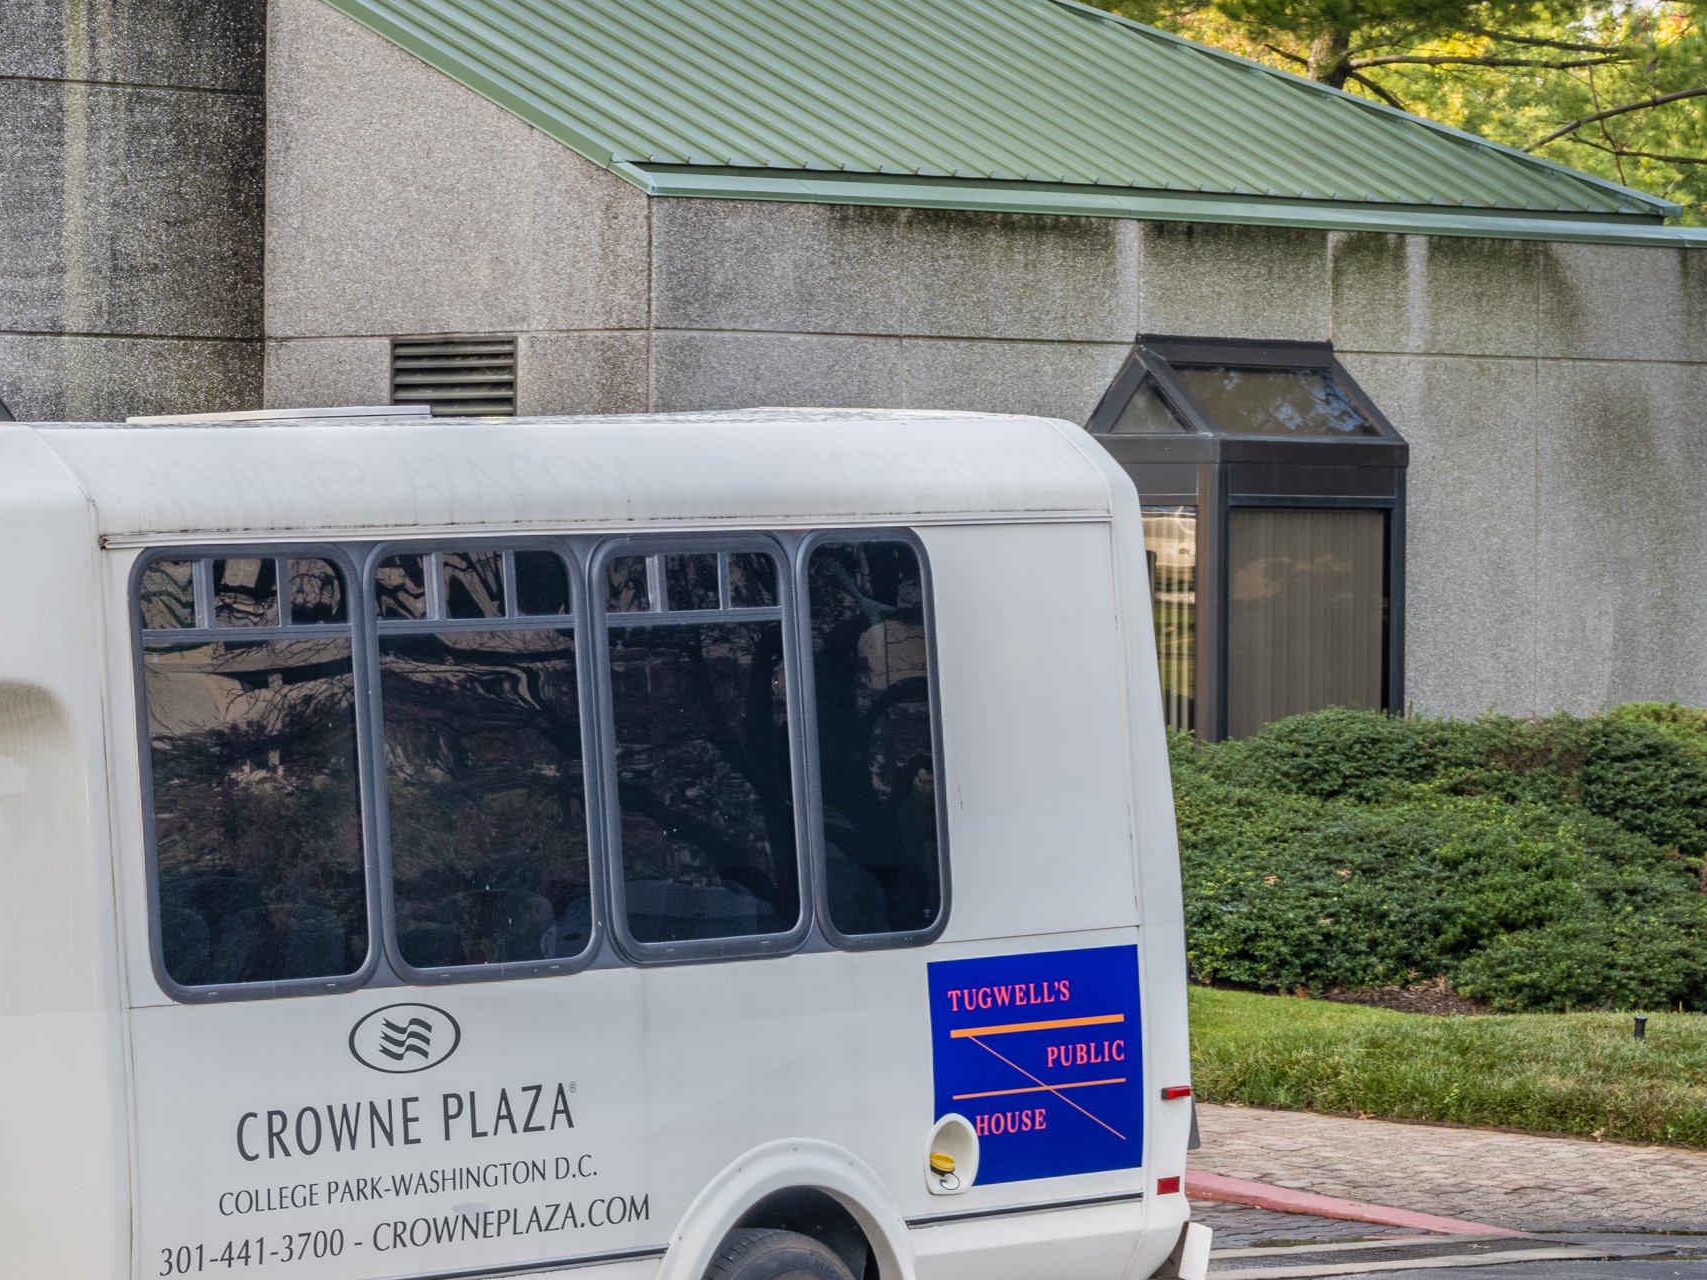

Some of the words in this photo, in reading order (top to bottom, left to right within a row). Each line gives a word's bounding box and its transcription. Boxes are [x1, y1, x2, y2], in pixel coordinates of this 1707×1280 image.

[947, 980, 1071, 1012] TUGWELL'S
[1046, 1040, 1126, 1068] PUBLIC
[236, 1096, 422, 1162] CROWNE
[975, 1108, 1047, 1136] HOUSE
[218, 1183, 319, 1216] COLLEGE
[327, 1159, 546, 1204] PARK-WASHINGTON
[554, 1154, 598, 1180] D.C.
[159, 1228, 345, 1277] 301-441-3700
[372, 1193, 651, 1252] CROWNEPLAZA.COM
